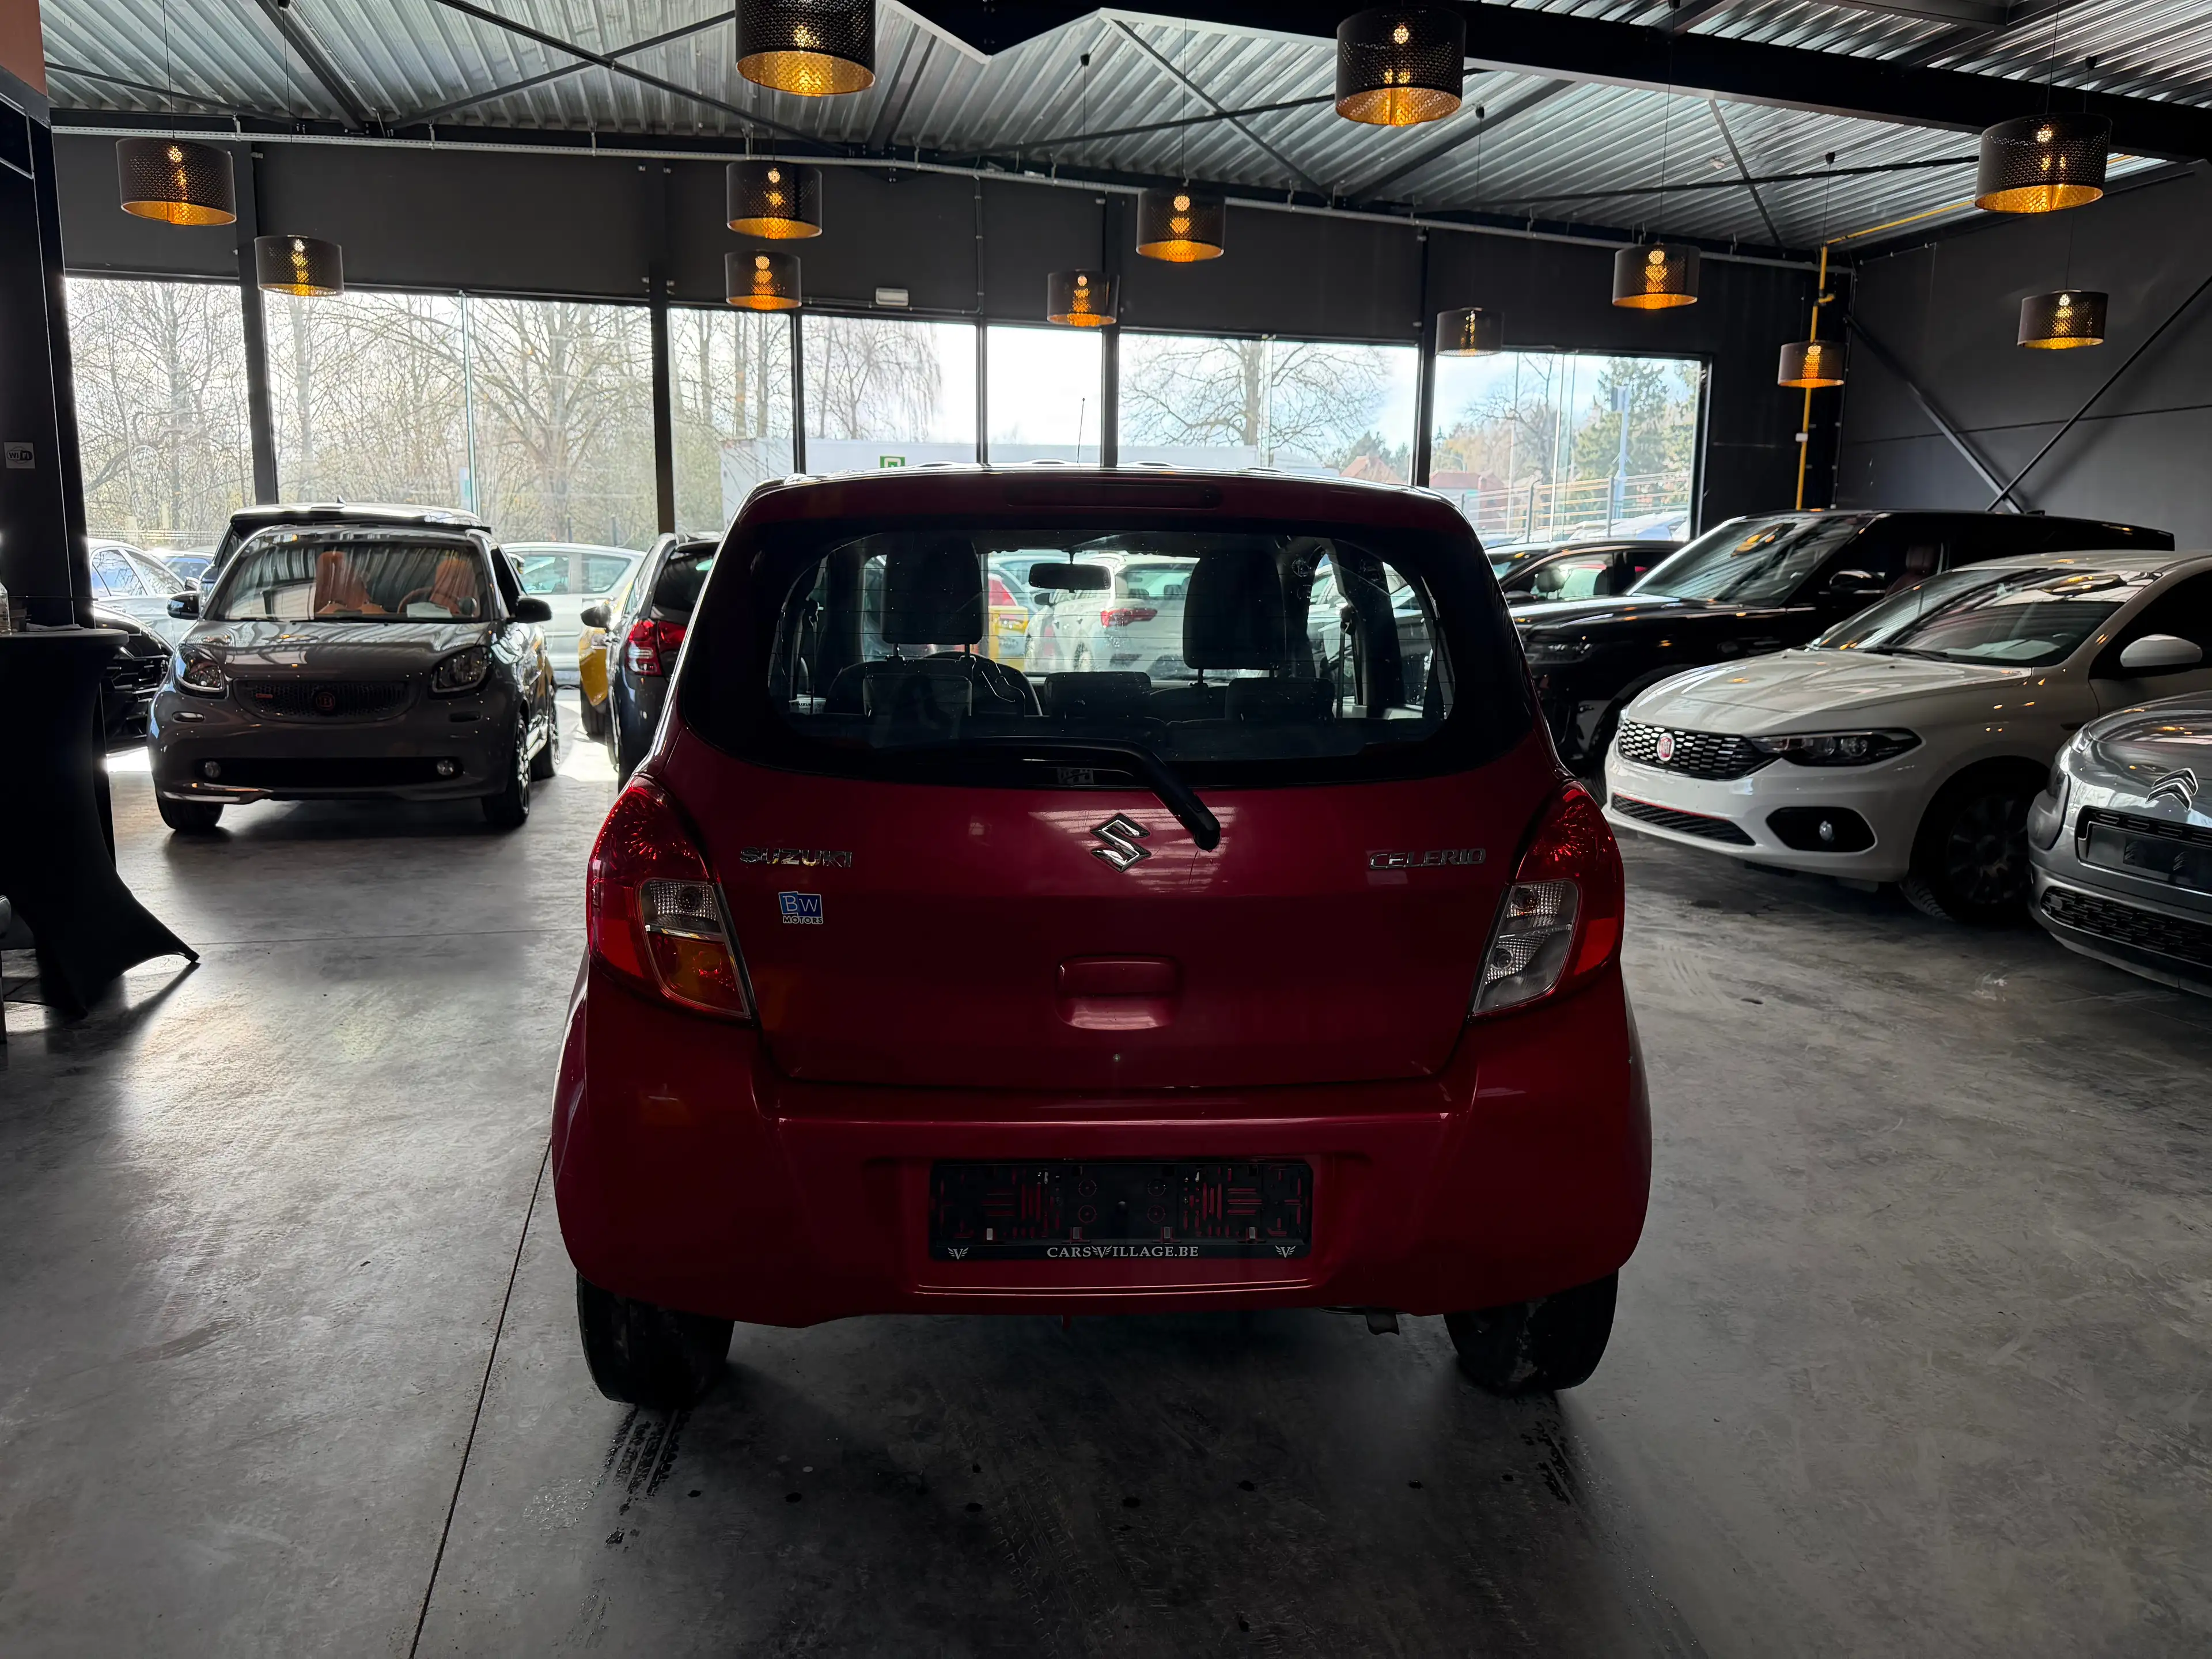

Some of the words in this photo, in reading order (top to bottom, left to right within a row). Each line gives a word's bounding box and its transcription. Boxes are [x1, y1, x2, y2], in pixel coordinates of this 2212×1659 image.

[740, 847, 852, 868] SUZUKI
[1370, 848, 1486, 869] CELERIO
[783, 916, 823, 924] MOTORS
[1047, 1245, 1198, 1258] CARSVILLAGE.BE
